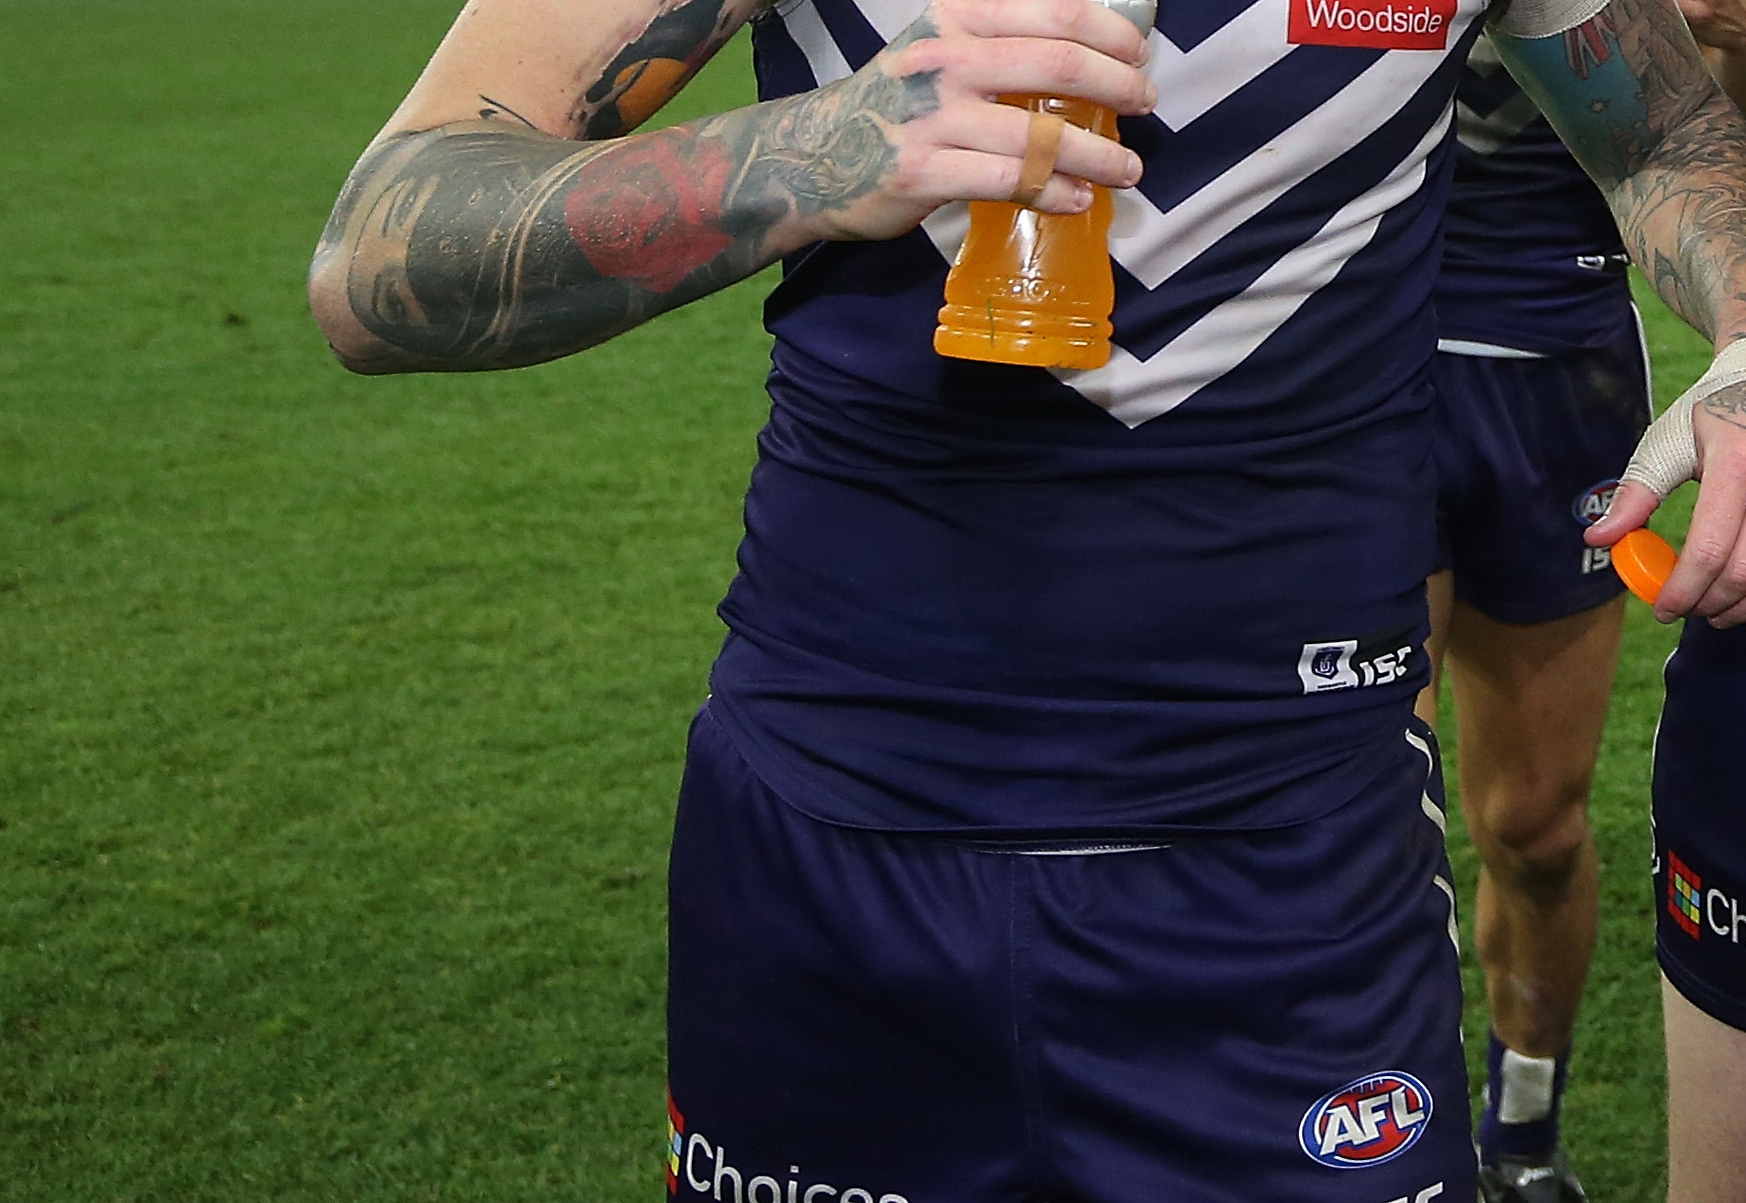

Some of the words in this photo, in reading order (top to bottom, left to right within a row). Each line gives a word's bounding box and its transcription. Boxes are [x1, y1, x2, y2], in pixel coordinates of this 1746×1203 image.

[1306, 0, 1443, 34] Woodside
[1580, 489, 1615, 518] AF
[1582, 546, 1611, 574] IS
[1320, 1086, 1425, 1156] AFL
